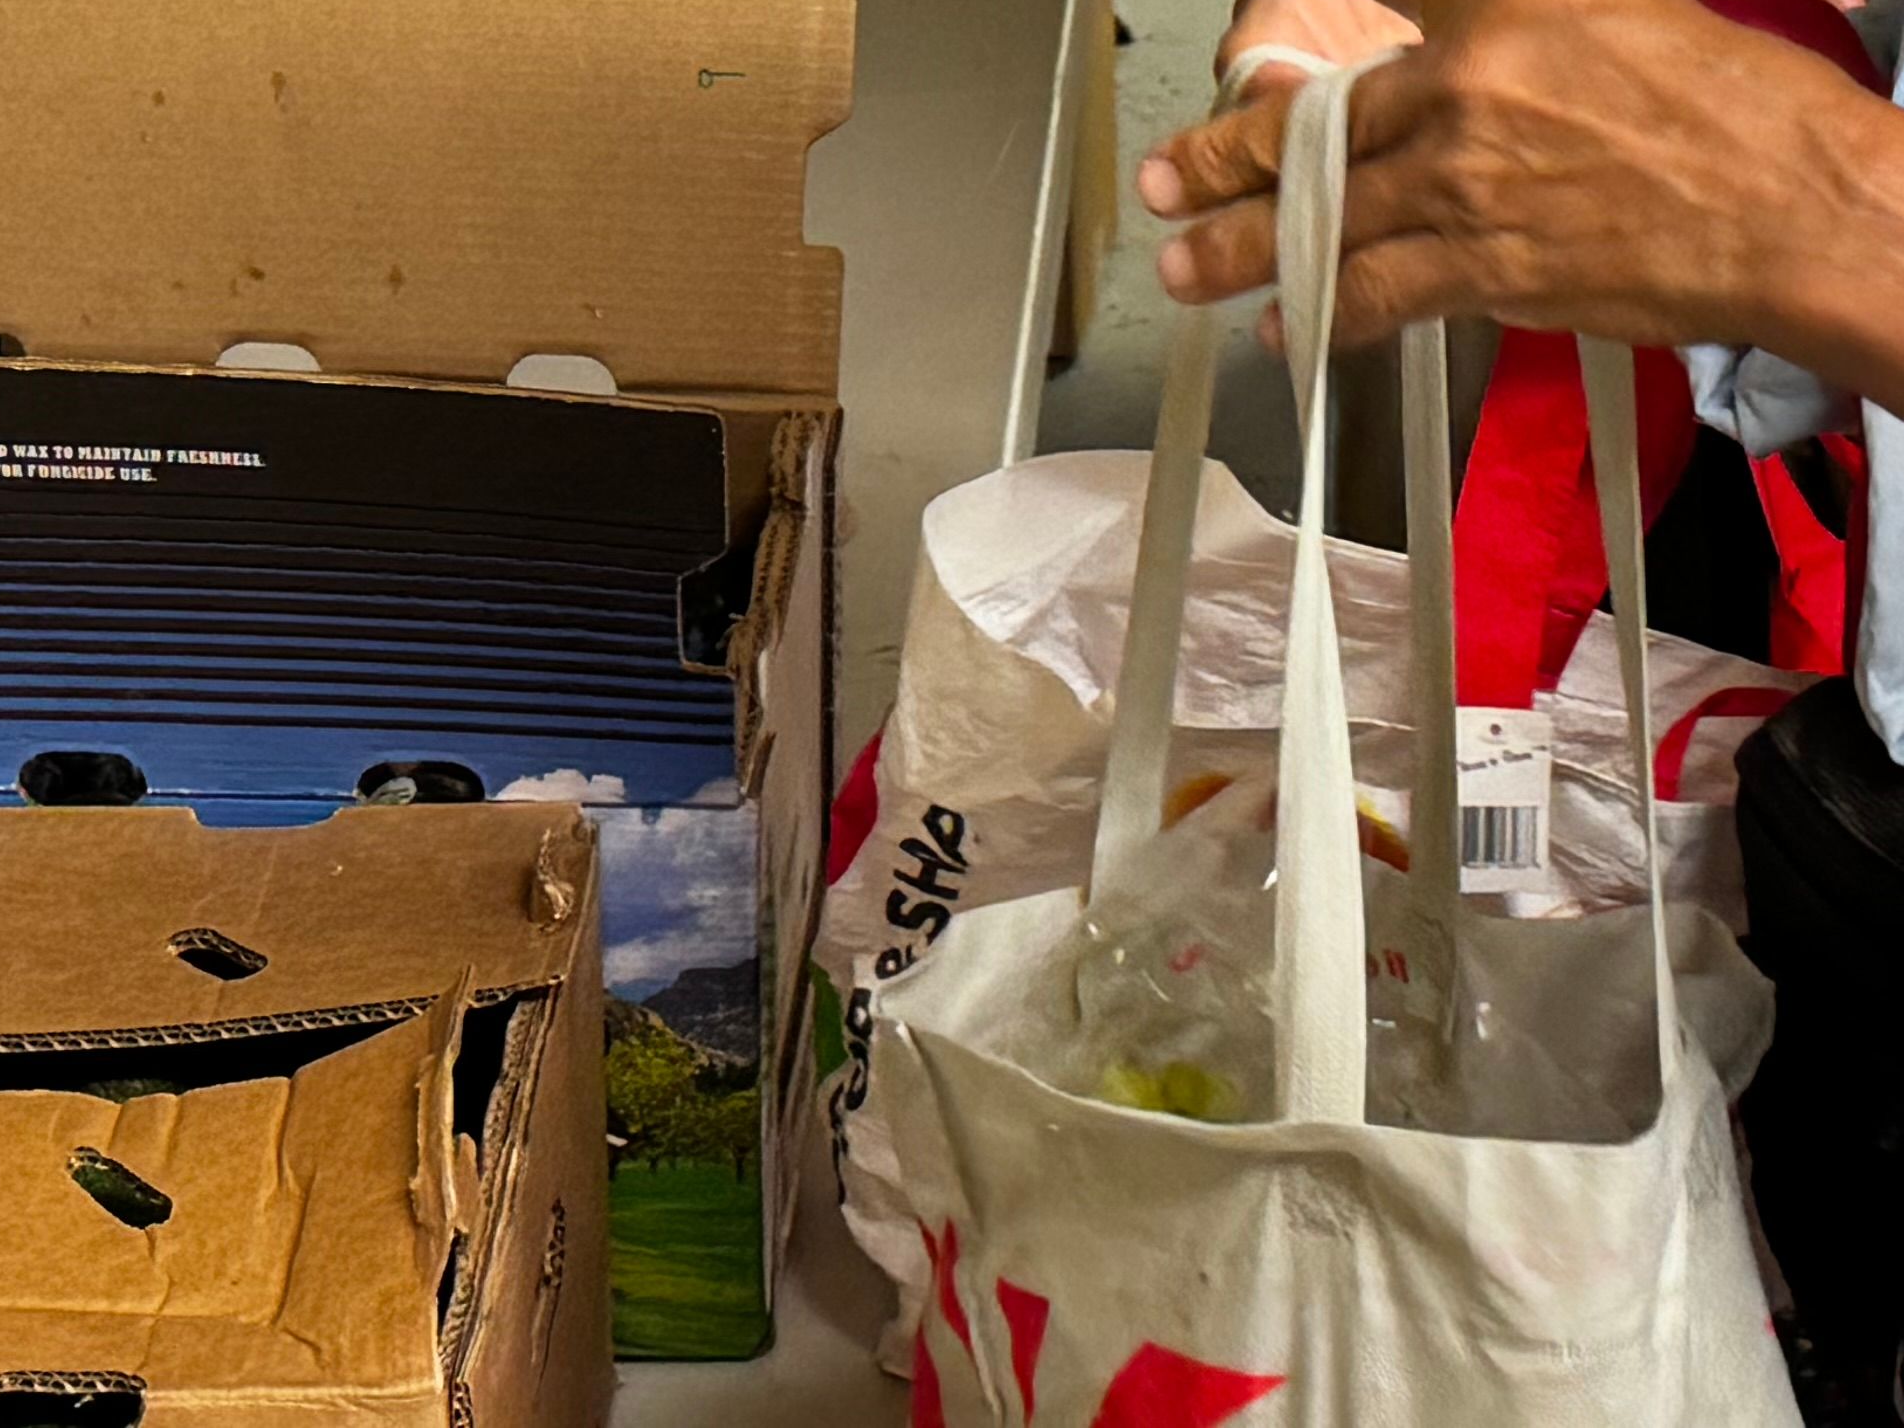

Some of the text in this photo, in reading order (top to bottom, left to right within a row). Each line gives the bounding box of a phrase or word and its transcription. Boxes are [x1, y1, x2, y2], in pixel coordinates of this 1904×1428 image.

[12, 444, 49, 459] WAX
[52, 445, 74, 460] TO
[77, 446, 162, 463] MAINTAIN
[166, 449, 266, 467] FRESHNESS.
[27, 463, 116, 480] FUNGICIDE
[119, 467, 157, 482] USE.
